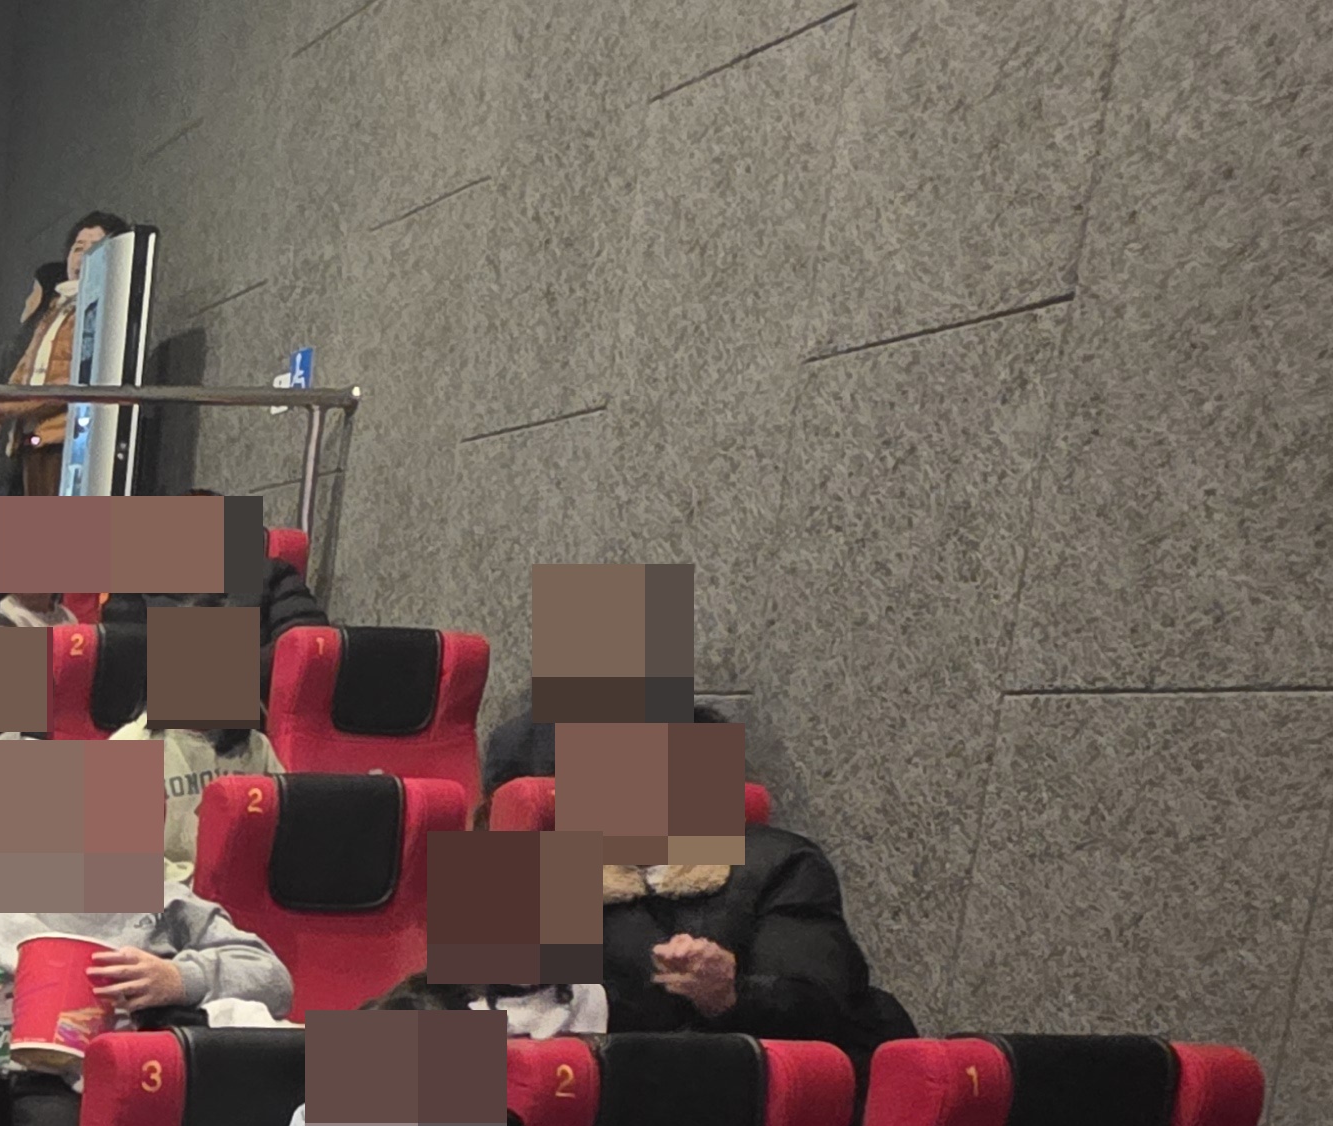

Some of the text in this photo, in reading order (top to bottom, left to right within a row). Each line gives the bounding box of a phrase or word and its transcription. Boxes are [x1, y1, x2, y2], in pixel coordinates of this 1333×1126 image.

[70, 634, 84, 656] 2
[315, 637, 325, 656] 1
[247, 787, 263, 813] 2
[141, 1059, 162, 1093] 3
[555, 1063, 576, 1099] 2
[967, 1066, 979, 1097] 1
